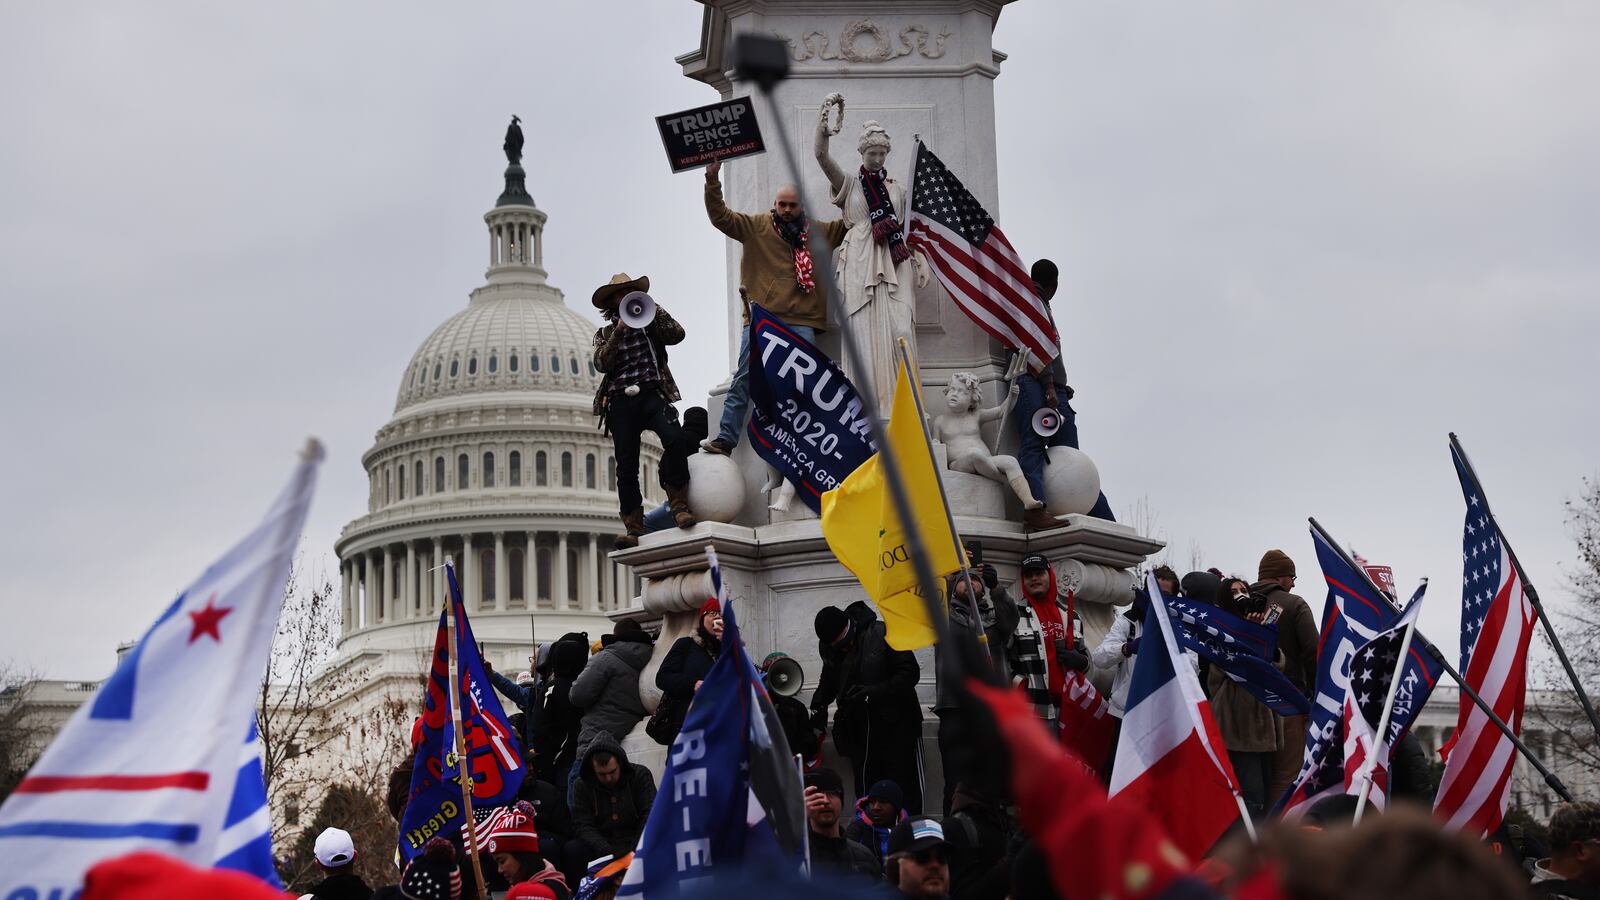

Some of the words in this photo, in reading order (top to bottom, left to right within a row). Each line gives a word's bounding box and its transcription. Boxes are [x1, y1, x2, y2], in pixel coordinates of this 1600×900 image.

[665, 103, 746, 134] TRUMP
[683, 122, 741, 146] PENCE
[698, 138, 732, 152] 2020
[680, 155, 699, 164] KEEP
[700, 148, 731, 161] AMERICA
[732, 142, 756, 152] GREAT
[762, 331, 880, 453] TRUM
